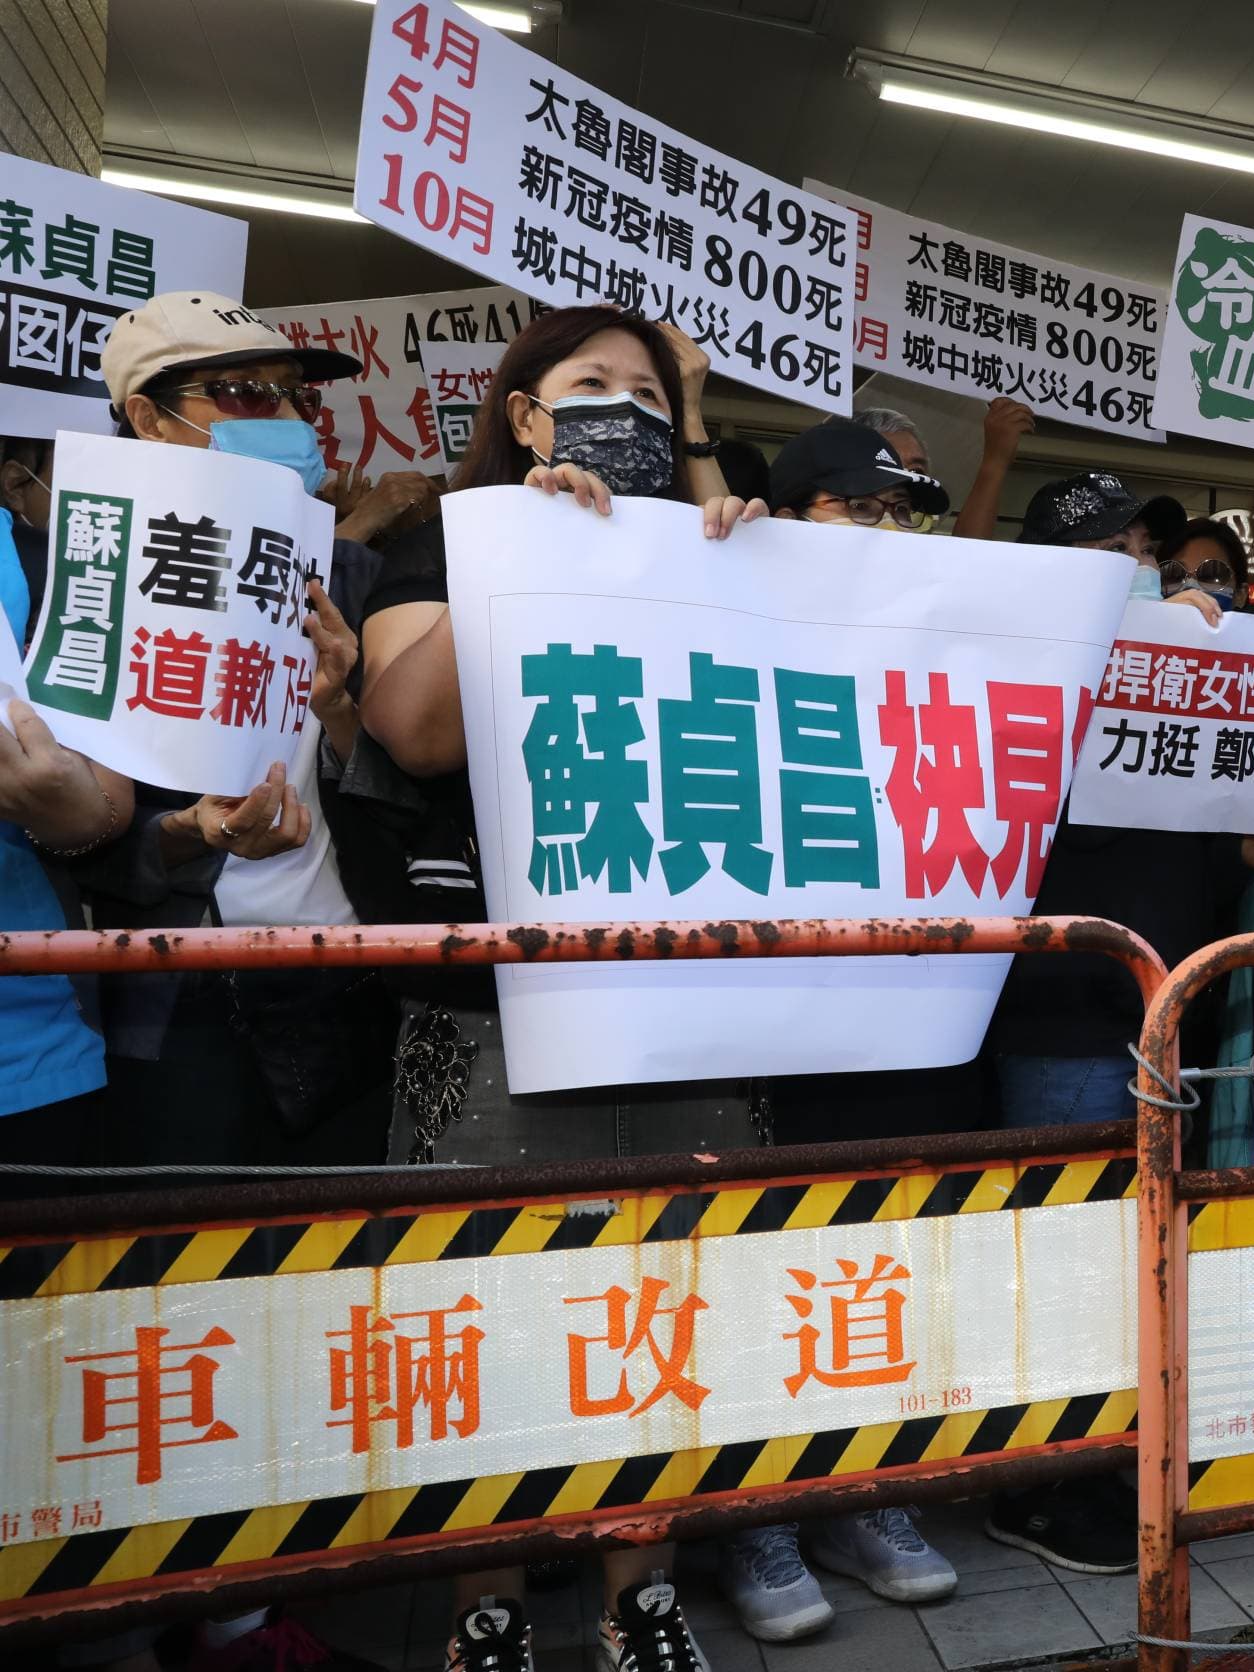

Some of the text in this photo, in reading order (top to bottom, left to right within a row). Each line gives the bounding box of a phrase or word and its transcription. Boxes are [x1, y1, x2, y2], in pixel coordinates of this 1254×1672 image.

[381, 73, 471, 165] 5月
[391, 2, 846, 268] 4月 太魯閣事故49死
[378, 153, 494, 256] 10月
[907, 231, 1158, 333] 太魯閣事故49死
[902, 330, 1157, 430] 城中城火災46死
[43, 498, 125, 696] 蘇貞昌
[127, 626, 274, 728] 道歉
[1100, 718, 1201, 778] 力挺
[55, 1254, 919, 1486] 車輛改道
[900, 1386, 972, 1413] 101-183
